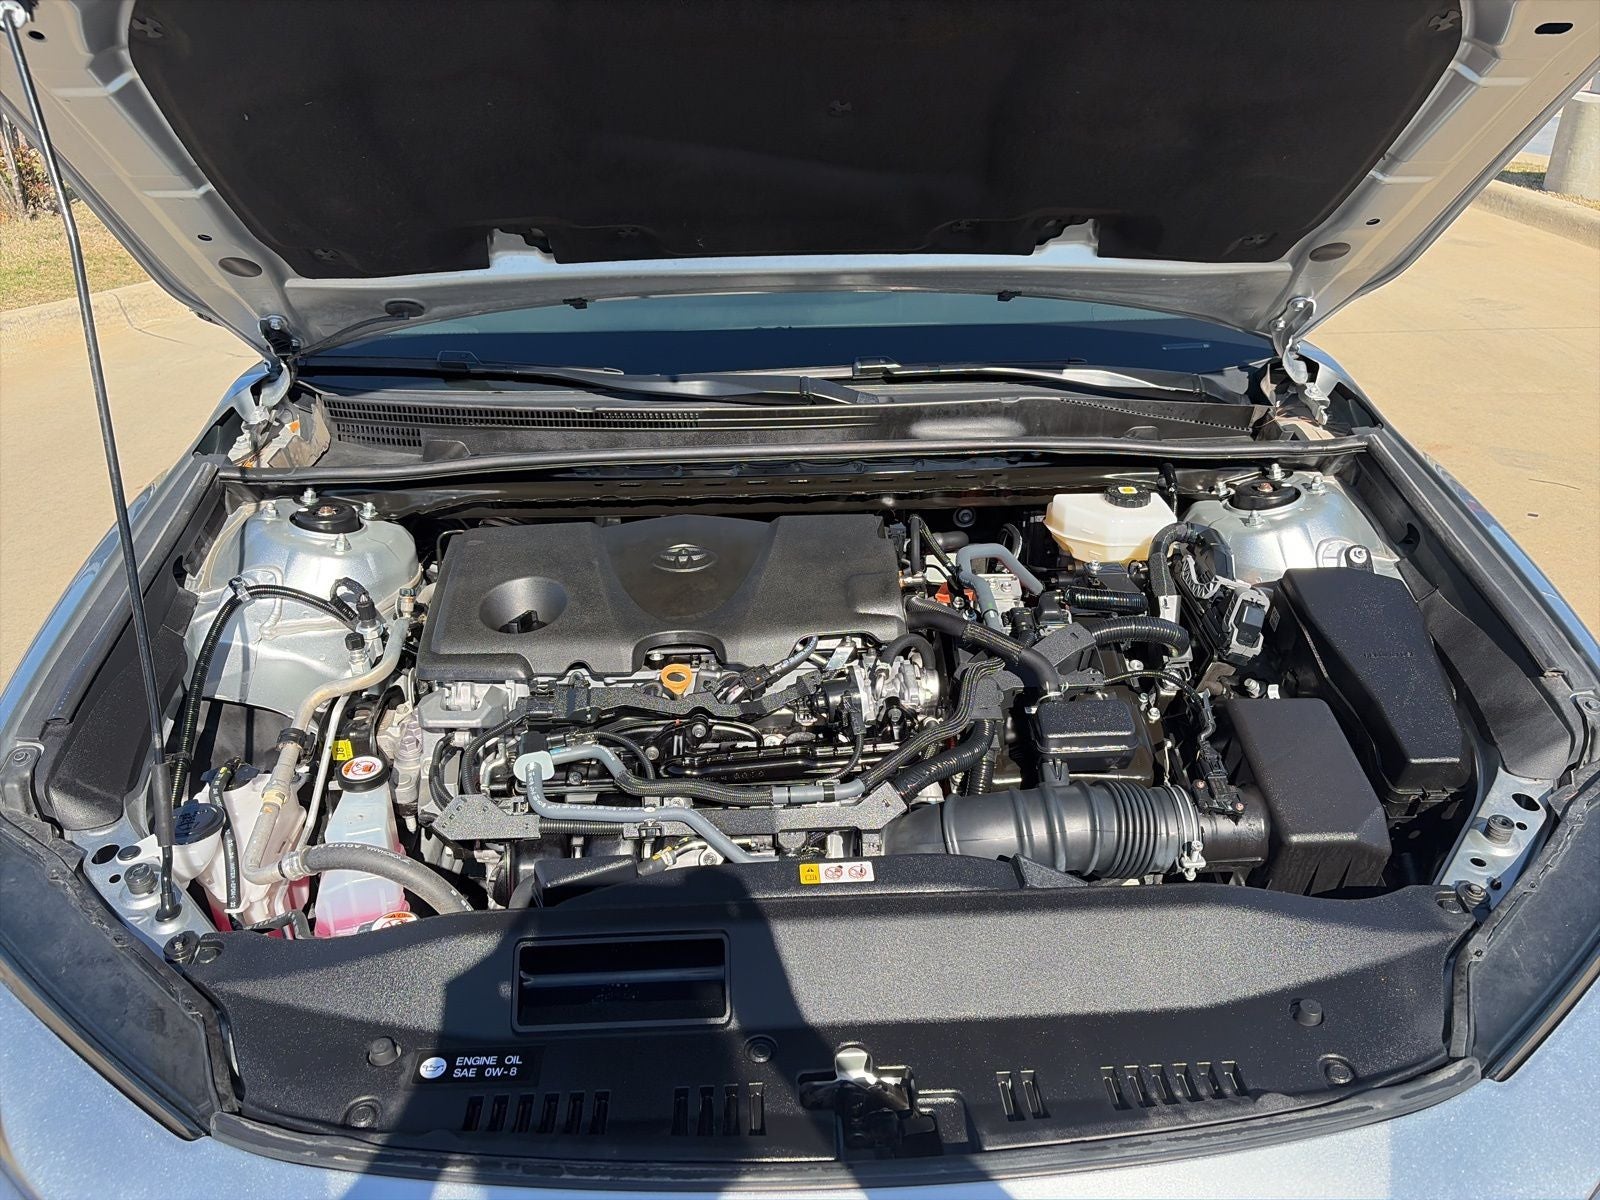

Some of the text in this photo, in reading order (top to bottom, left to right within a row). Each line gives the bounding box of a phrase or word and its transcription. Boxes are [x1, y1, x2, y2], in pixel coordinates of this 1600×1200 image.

[455, 1055, 523, 1066] ENGINE OIL
[453, 1067, 518, 1078] SAE 0W-8
